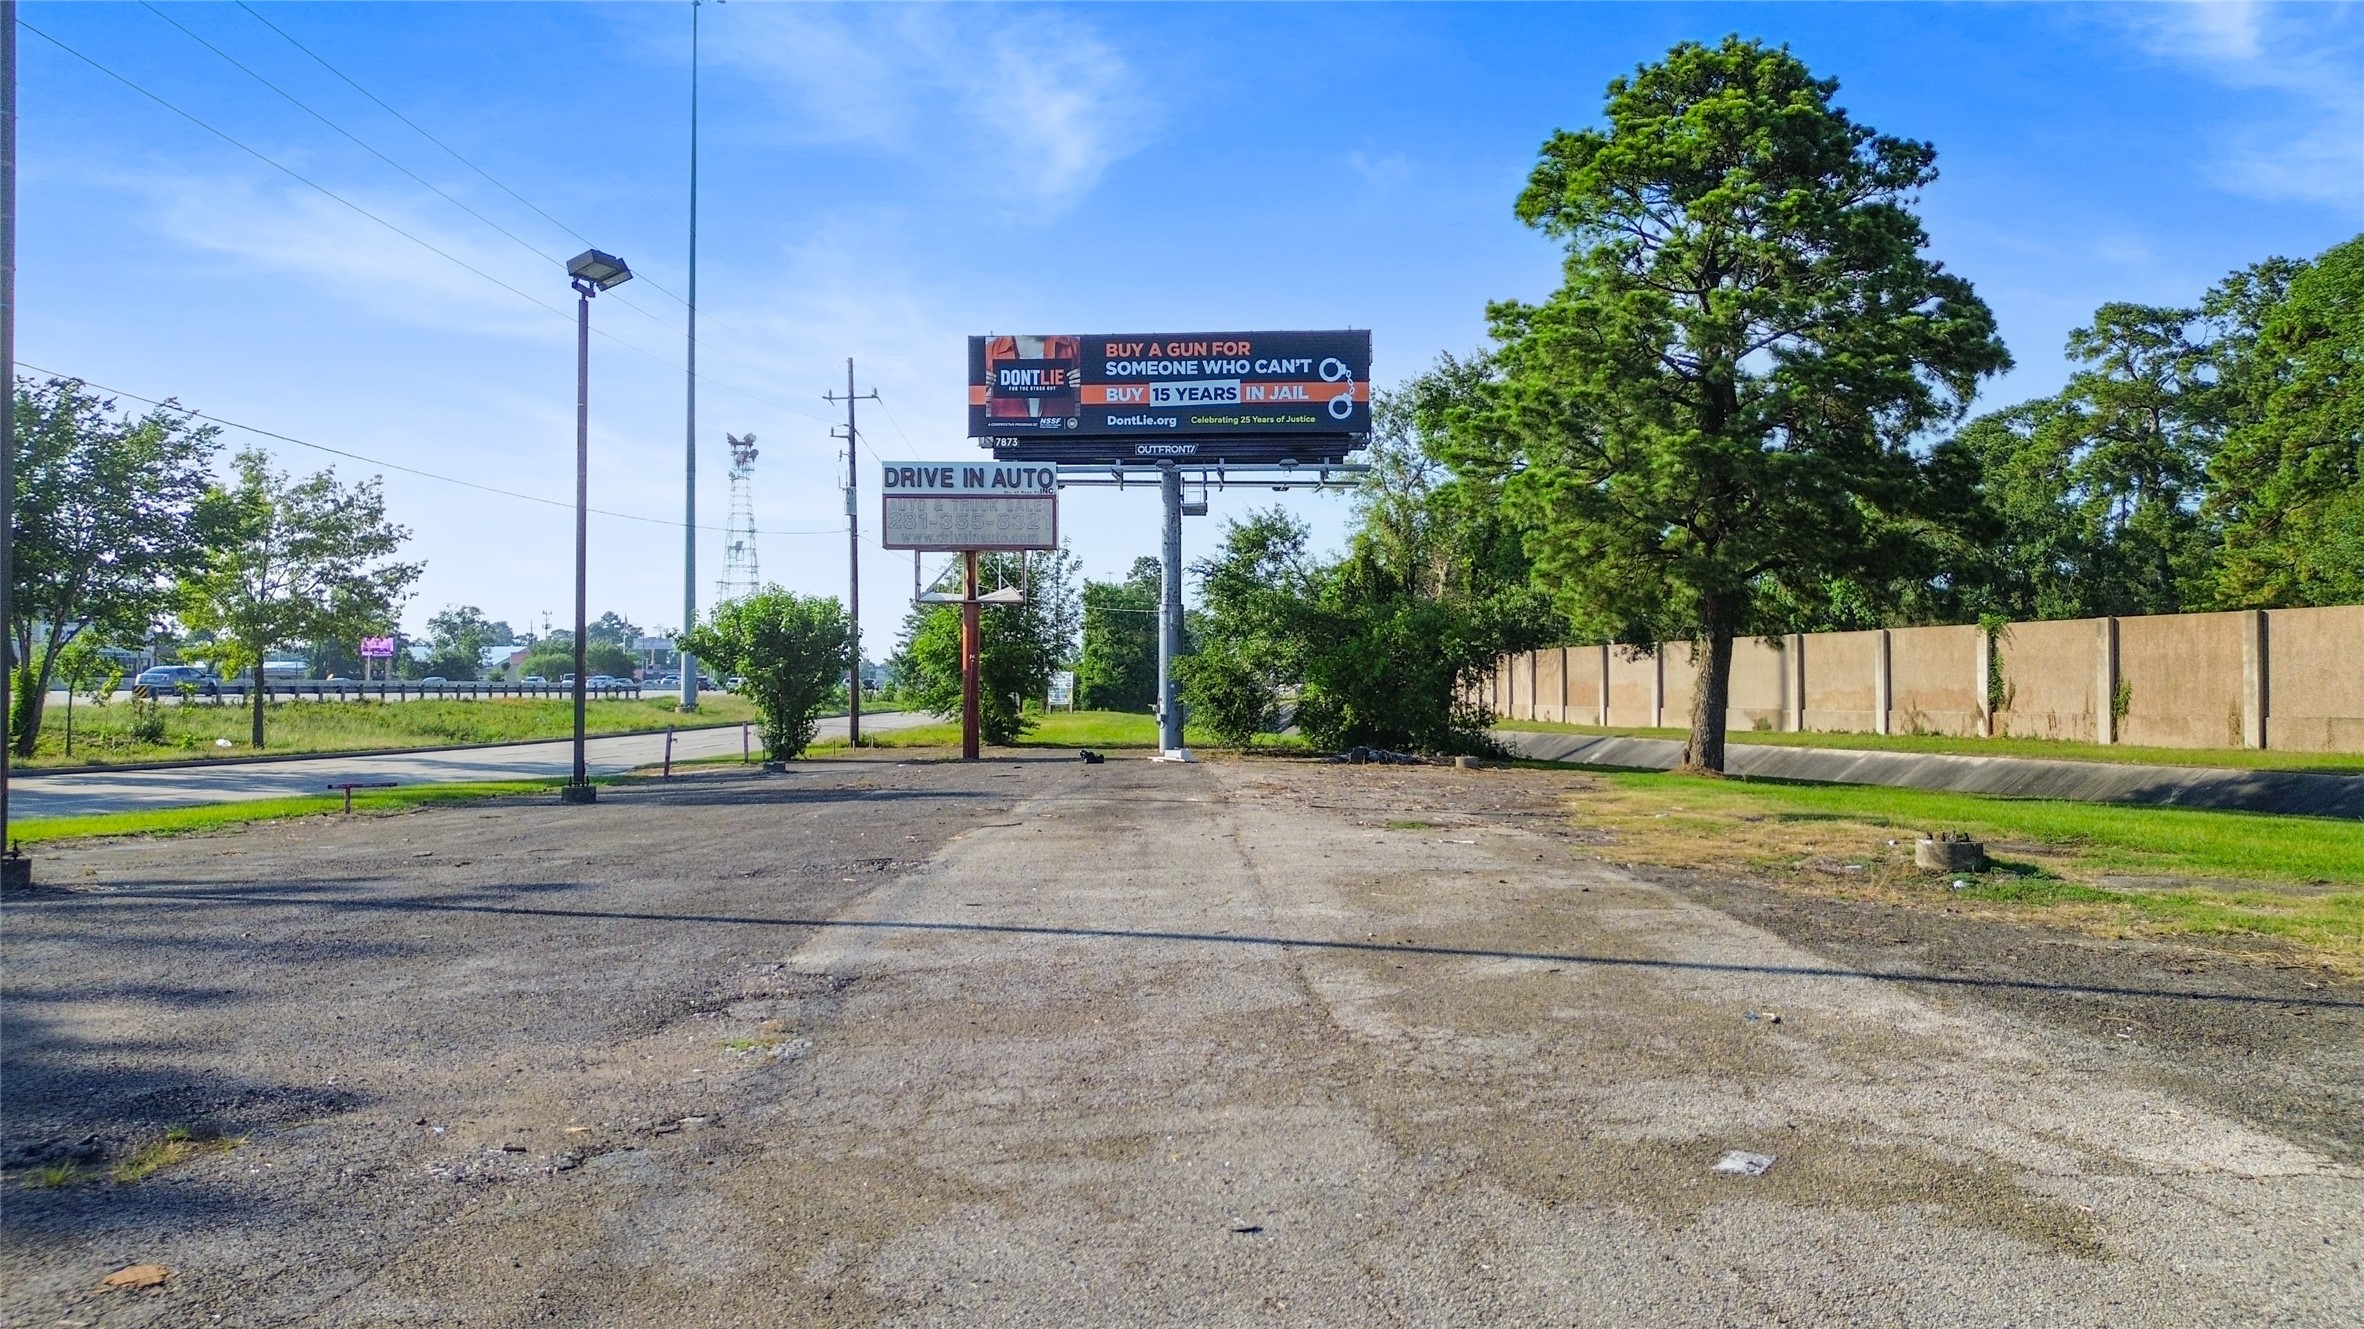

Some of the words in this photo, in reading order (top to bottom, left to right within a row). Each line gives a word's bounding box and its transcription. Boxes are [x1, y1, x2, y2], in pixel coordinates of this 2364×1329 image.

[1105, 343, 1144, 357] BUY
[1148, 342, 1162, 357] A
[1166, 341, 1207, 357] GUN
[1212, 341, 1251, 356] FOR
[1105, 360, 1198, 376] SOMEONE
[1202, 359, 1251, 375] WHO
[1254, 359, 1313, 374] CAN'T
[1106, 387, 1144, 402] BUY
[1152, 387, 1171, 402] 15
[1175, 386, 1237, 401] YEARS
[1245, 386, 1265, 400] IN
[1269, 385, 1309, 400] JAIL
[1107, 414, 1177, 428] DontLie.org
[1190, 415, 1239, 425] Celebrating
[1240, 415, 1251, 424] 25
[1252, 415, 1275, 424] Years
[1276, 414, 1285, 423] of
[1286, 414, 1316, 423] Justice
[995, 437, 1018, 447] 7873
[884, 467, 954, 488] DRIVE
[963, 467, 984, 488] IN
[991, 467, 1054, 488] AUTO
[889, 499, 927, 512] AUTO
[934, 499, 944, 512] &
[952, 499, 999, 512] TRUCK
[1005, 499, 1051, 512] SALES
[888, 512, 1051, 530] 281-355-8321
